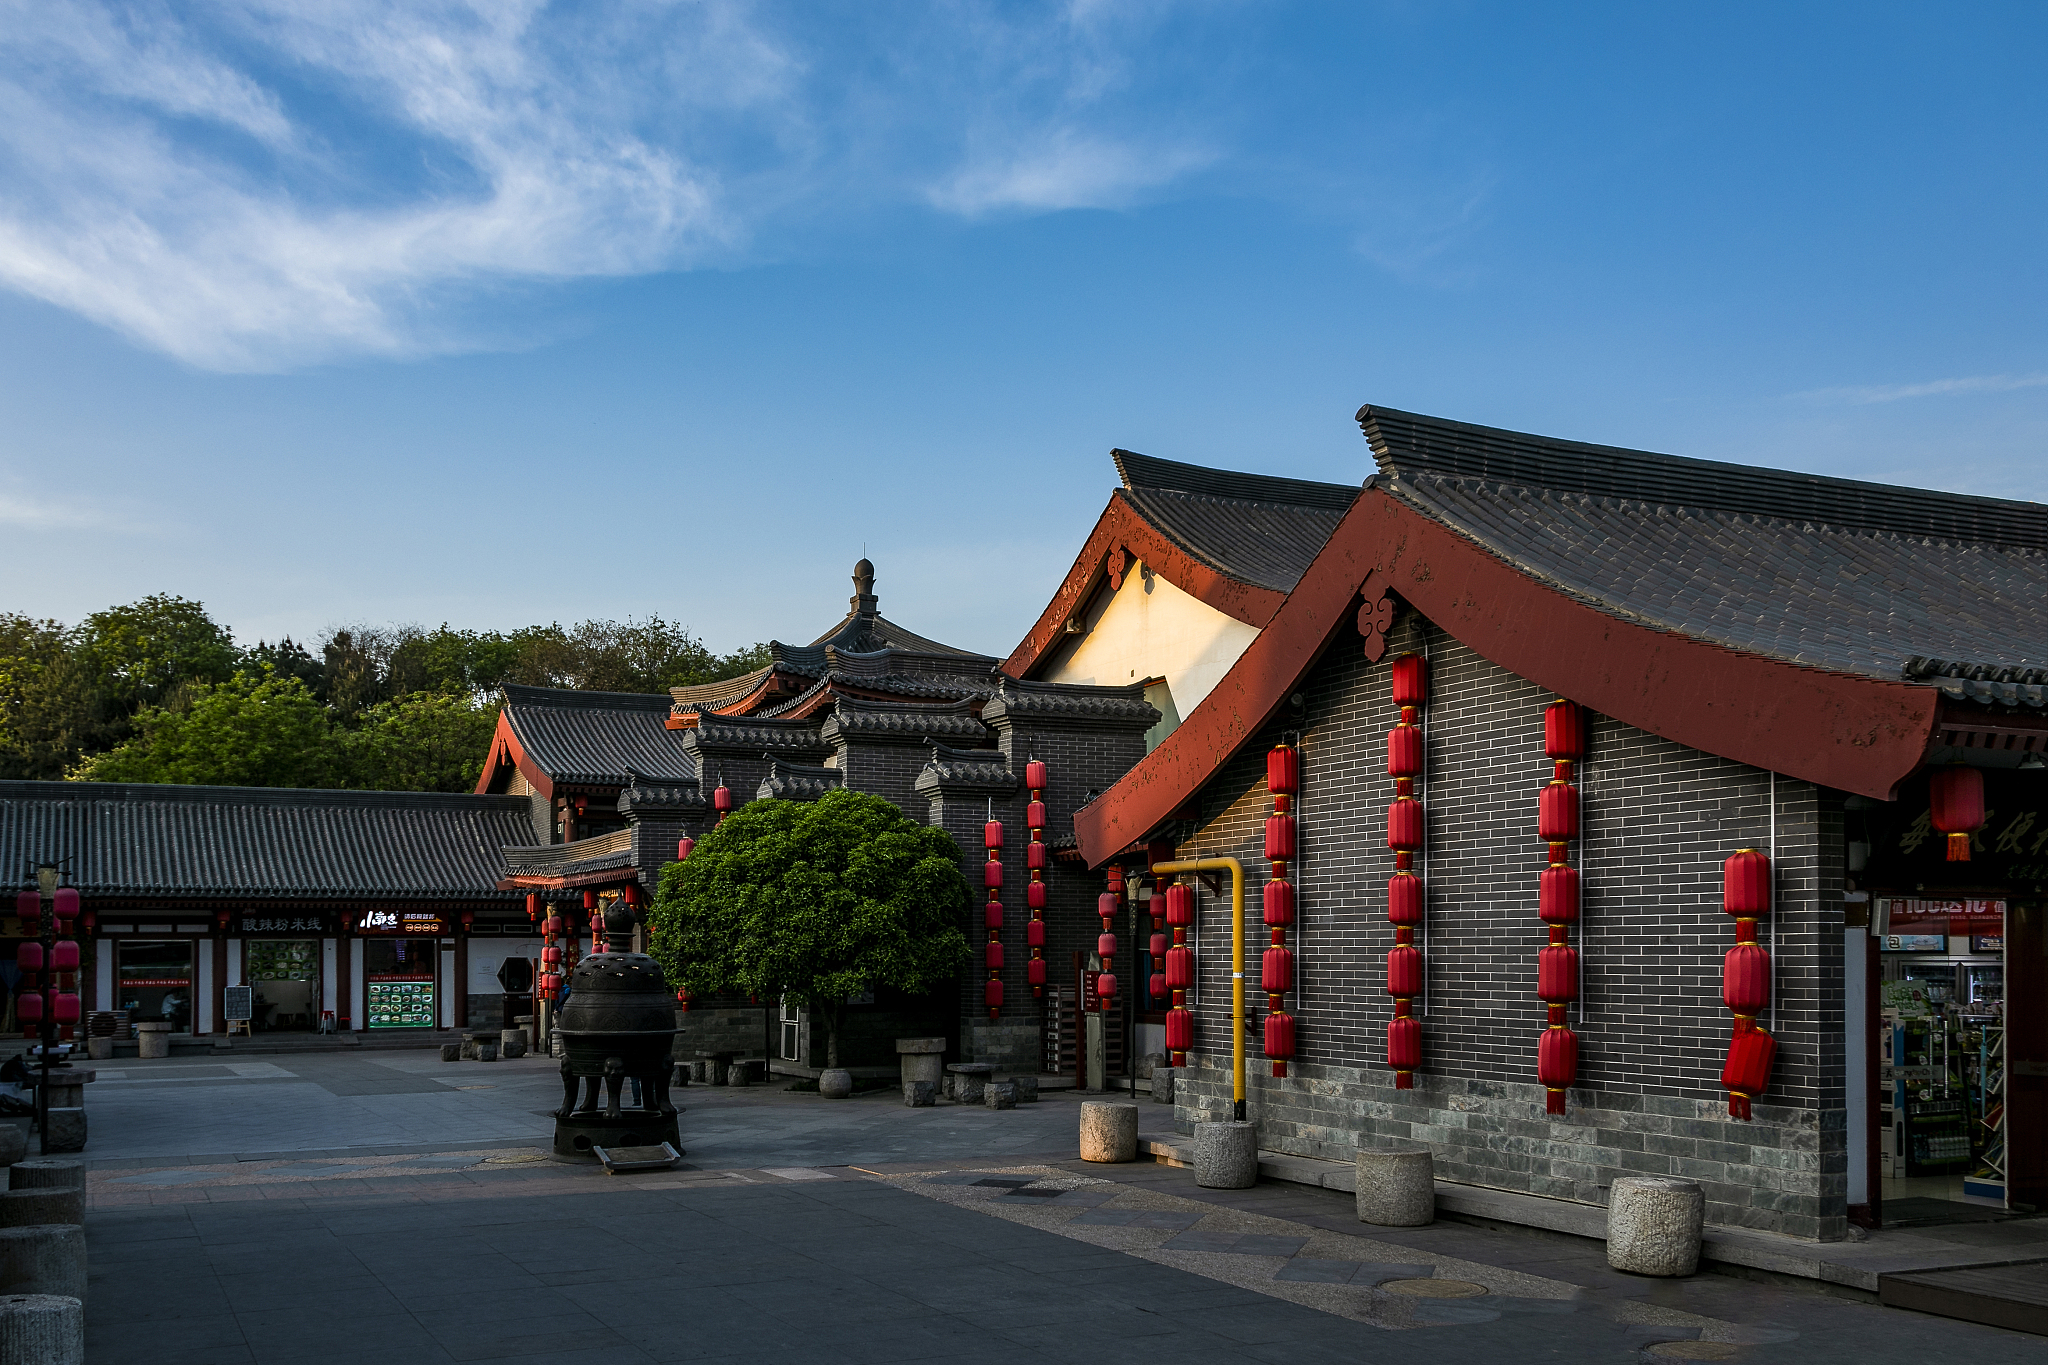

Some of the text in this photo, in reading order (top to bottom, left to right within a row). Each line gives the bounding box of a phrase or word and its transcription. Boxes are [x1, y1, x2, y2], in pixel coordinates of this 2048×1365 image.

[241, 917, 323, 932] 酸辣粉米线
[1887, 935, 1901, 949] 包
